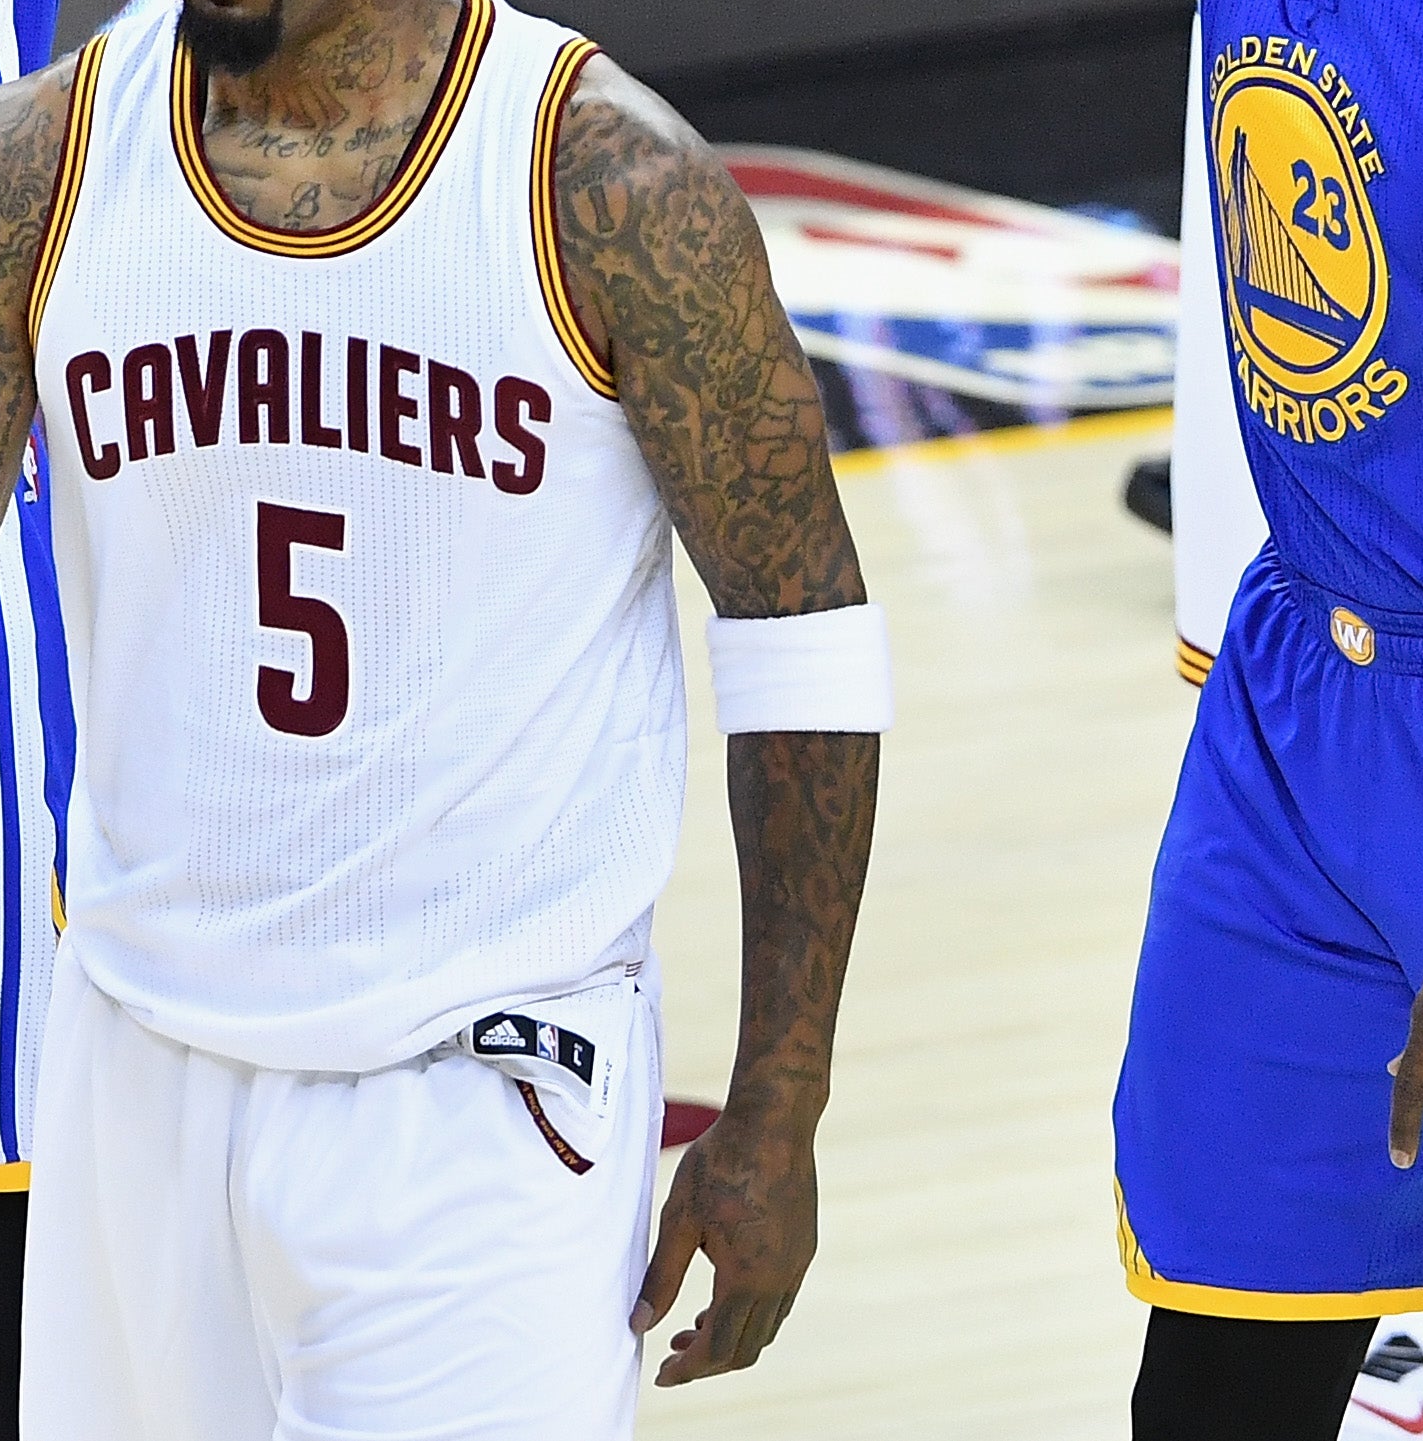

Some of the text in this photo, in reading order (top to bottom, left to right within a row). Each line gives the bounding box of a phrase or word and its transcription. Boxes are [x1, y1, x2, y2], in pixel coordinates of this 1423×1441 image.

[1209, 35, 1385, 183] GOLDEN STATE
[1290, 158, 1351, 252] 23
[65, 327, 553, 496] CAVALIERS
[1228, 303, 1408, 444] ARRIORS
[256, 500, 350, 738] 5
[1334, 618, 1370, 655] W
[479, 1034, 526, 1048] adidas
